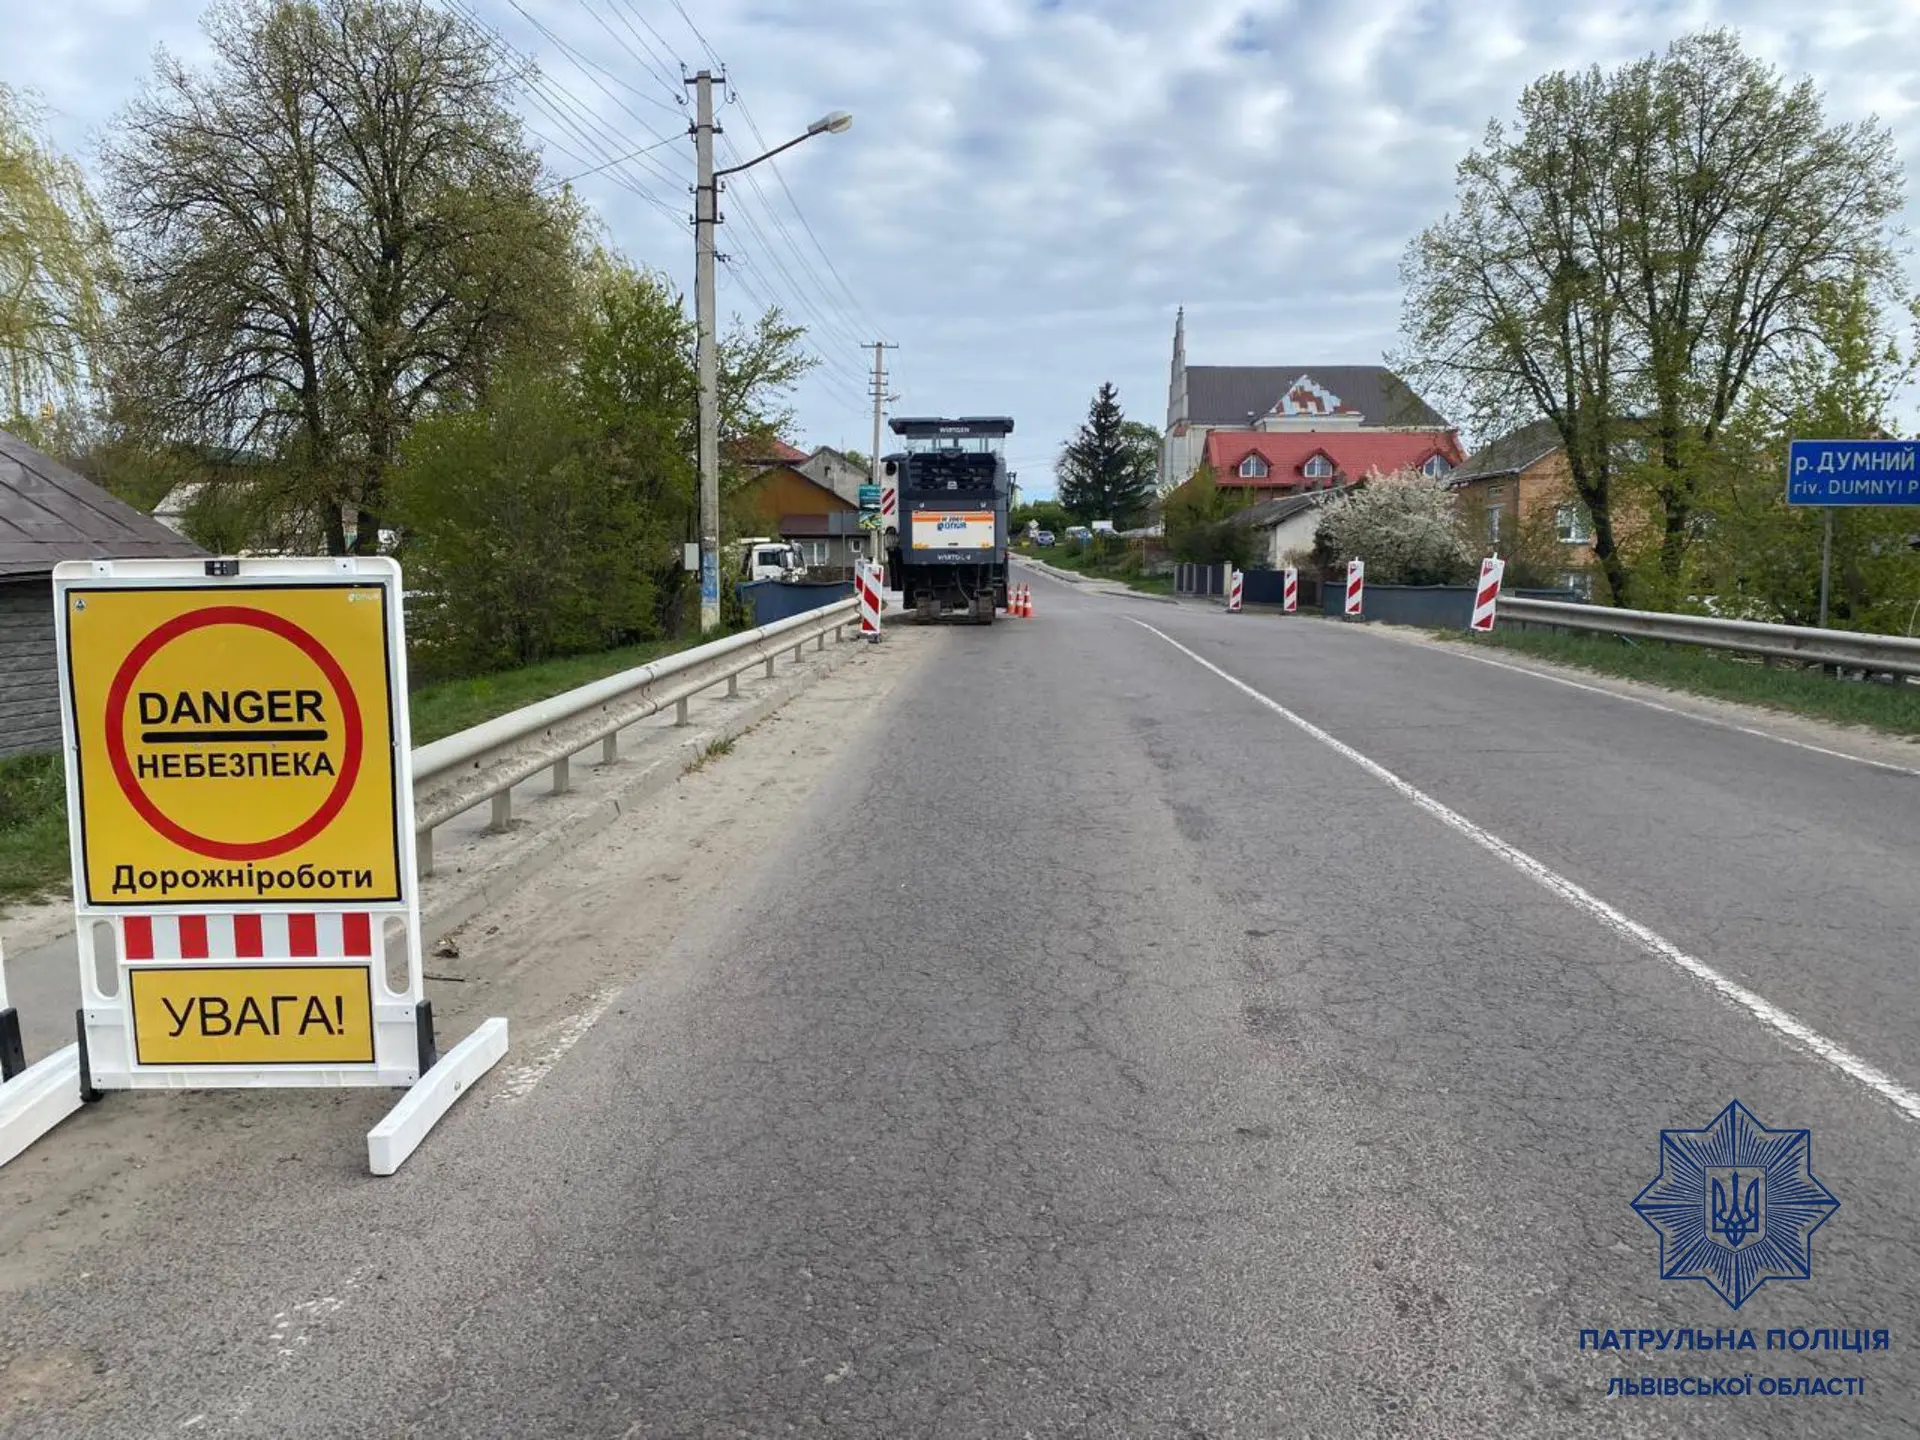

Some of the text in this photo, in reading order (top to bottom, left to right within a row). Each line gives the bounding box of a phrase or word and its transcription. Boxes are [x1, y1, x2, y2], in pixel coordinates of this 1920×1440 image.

[1793, 481, 1822, 494] riv.
[1828, 480, 1903, 494] DUMNYI
[138, 689, 326, 725] DANGER
[137, 751, 335, 779] НЕБЕЗПЕКА
[162, 995, 344, 1038] УВАГА!
